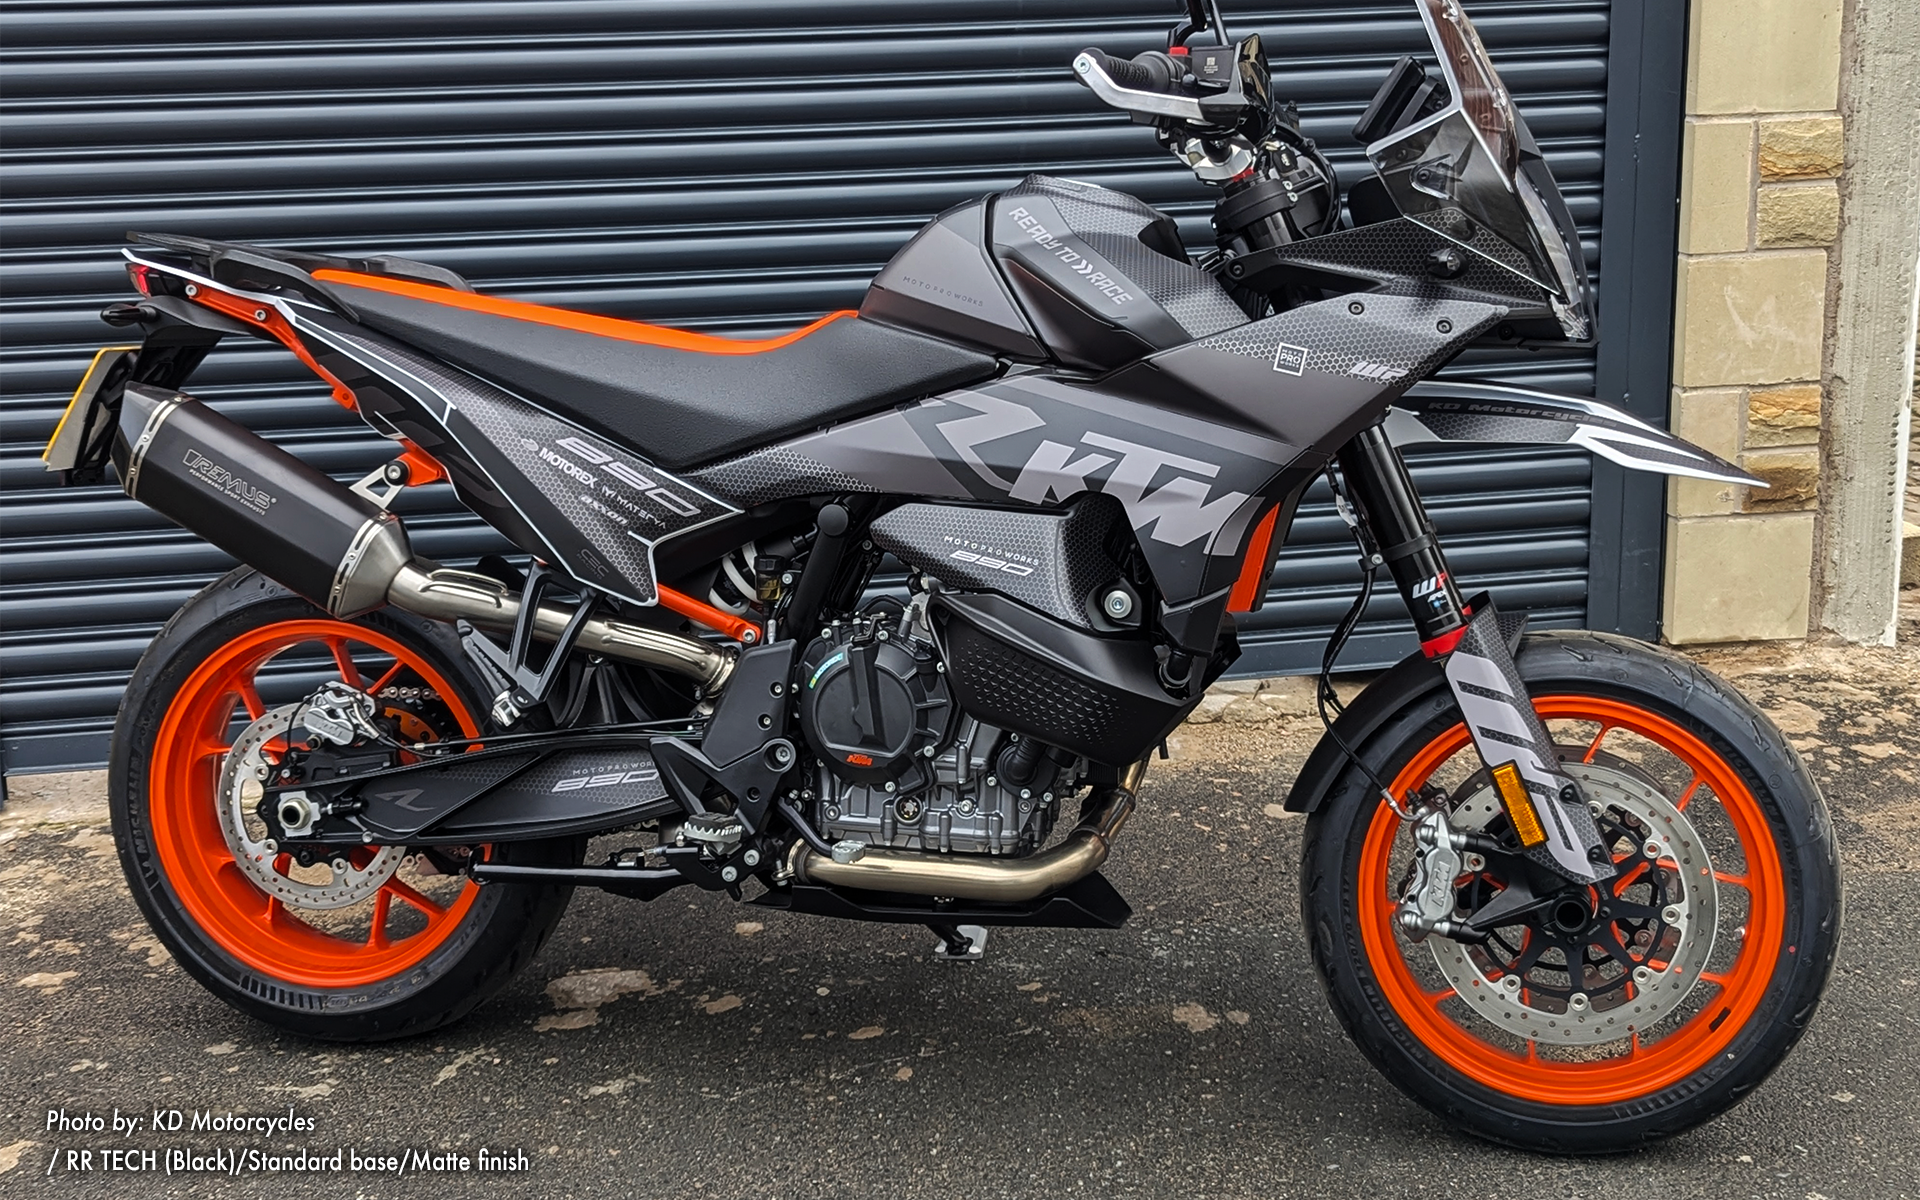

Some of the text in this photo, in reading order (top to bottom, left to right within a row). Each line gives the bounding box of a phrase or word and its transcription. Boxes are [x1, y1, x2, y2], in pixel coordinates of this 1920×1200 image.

[1008, 206, 1134, 306] READY TO RACE
[1280, 353, 1302, 364] PRO
[1427, 402, 1461, 410] KD
[538, 447, 598, 489] MOTOREX
[556, 436, 702, 518] 890
[1008, 430, 1266, 556] KTM
[950, 549, 1034, 577] 890
[551, 769, 660, 793] 890
[1431, 860, 1451, 908] KTM
[1362, 984, 1425, 1061] MICHELIN
